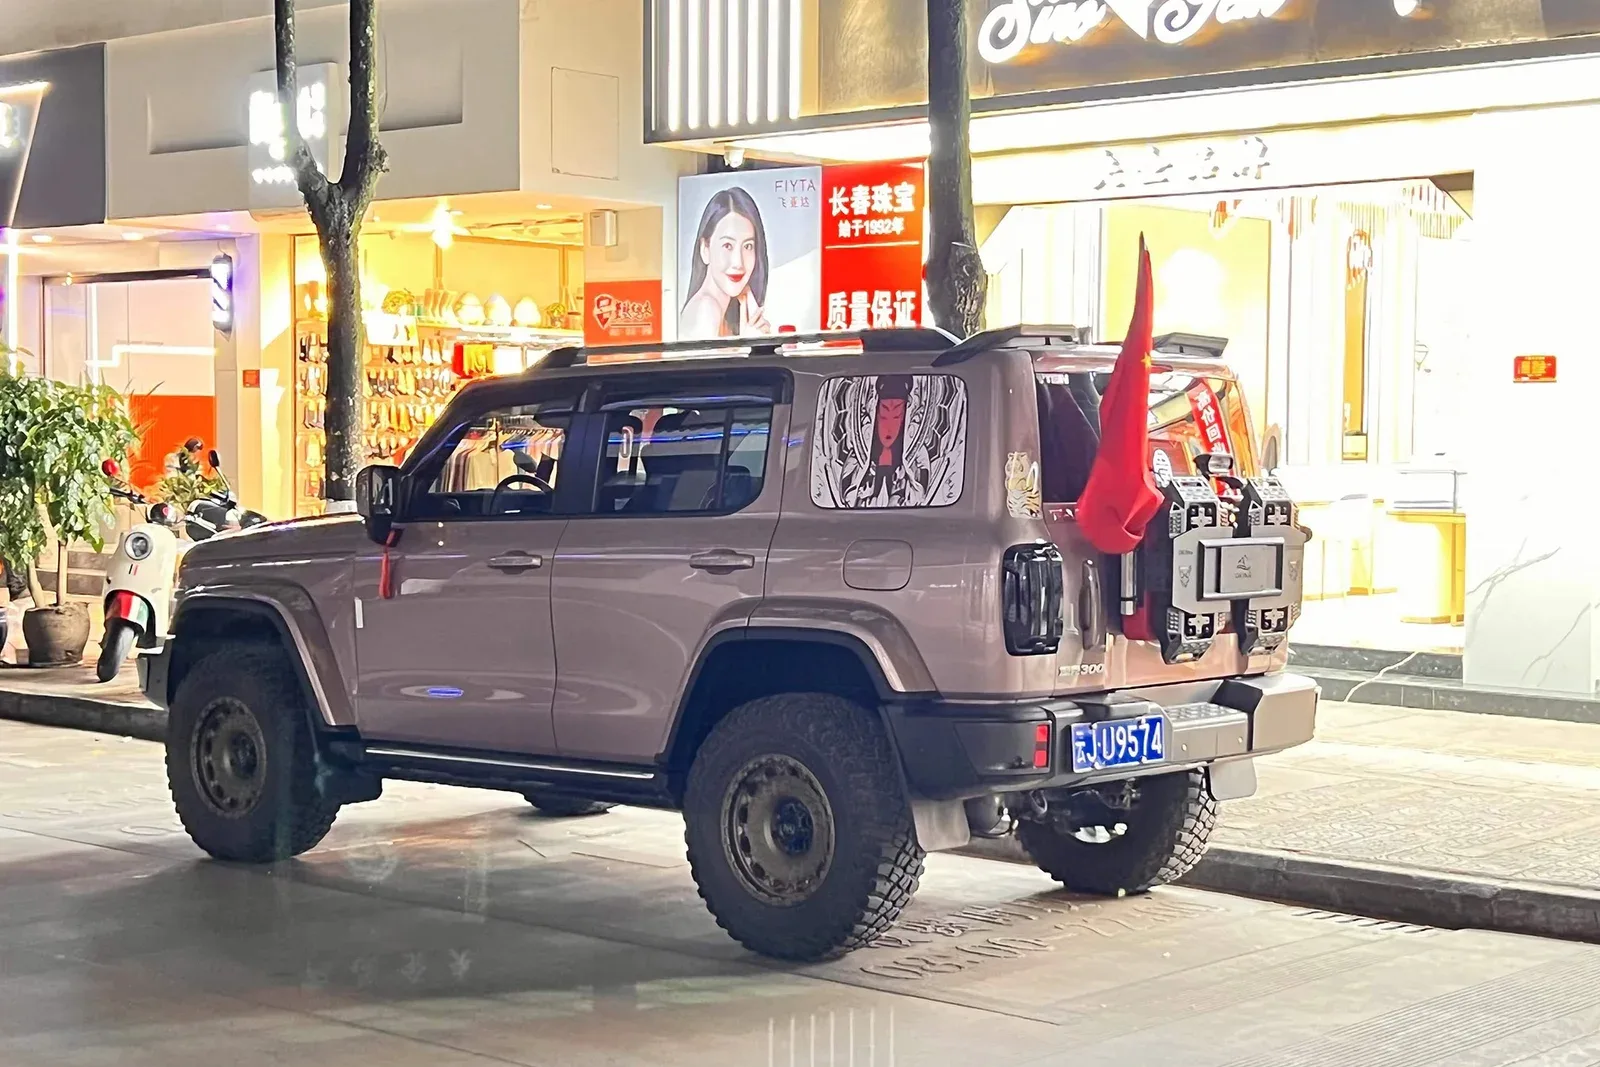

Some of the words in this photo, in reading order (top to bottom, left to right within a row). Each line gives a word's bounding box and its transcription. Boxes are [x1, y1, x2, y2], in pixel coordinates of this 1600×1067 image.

[774, 179, 816, 193] FIYTA
[778, 196, 810, 208] 飞亚达
[829, 181, 916, 217] 长春珠宝
[838, 217, 905, 238] 始于1992年
[826, 290, 917, 330] 质量保证
